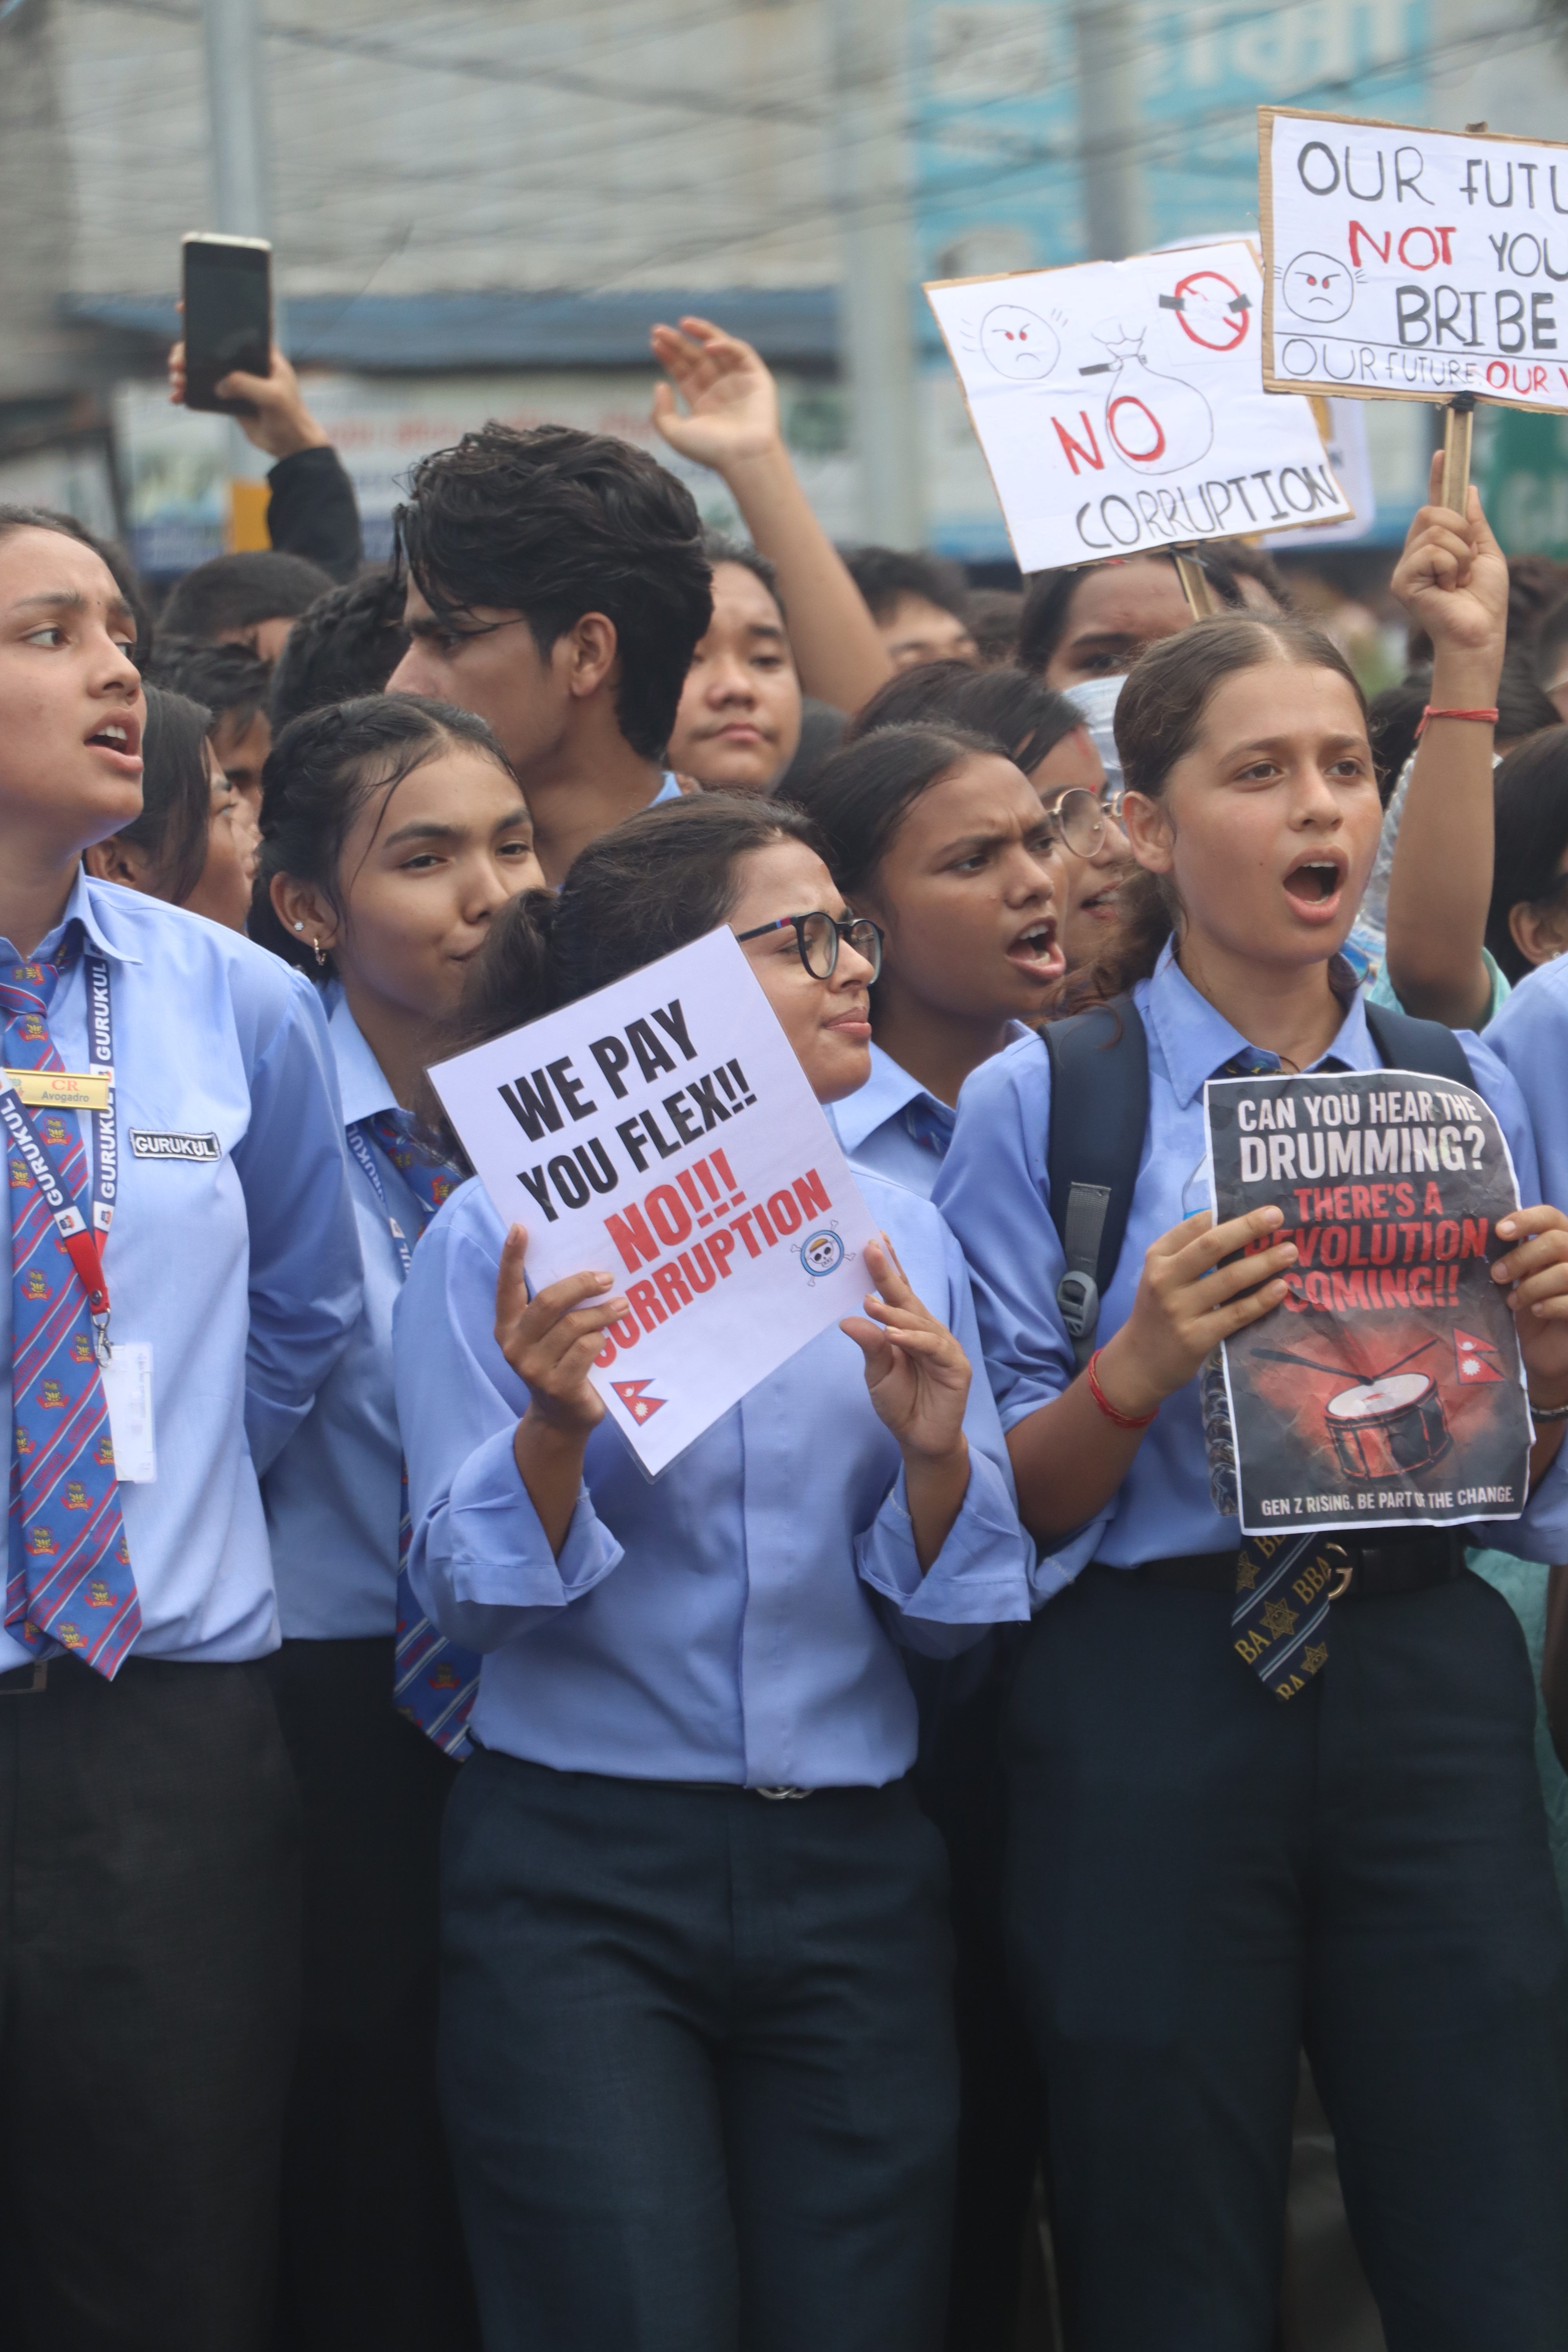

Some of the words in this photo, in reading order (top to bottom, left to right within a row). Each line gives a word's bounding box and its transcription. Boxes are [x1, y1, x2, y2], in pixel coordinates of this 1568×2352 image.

[1298, 142, 1435, 205] OUR
[1349, 220, 1456, 271] NOT
[1396, 285, 1557, 354] BRIBE
[1282, 338, 1377, 380] OUR
[1486, 361, 1549, 395] OUR
[1051, 396, 1165, 475] NO
[1076, 465, 1341, 548] CORRUPTION
[93, 963, 111, 1061] GURUKUL
[42, 1091, 89, 1103] Avogadro
[52, 1080, 80, 1091] CR
[497, 1055, 598, 1142] WE
[588, 998, 698, 1100] PAY
[1238, 1098, 1296, 1132] CAN
[1304, 1095, 1360, 1127] YOU
[1369, 1091, 1435, 1123] HEAR
[1435, 1092, 1483, 1122] THE
[1, 1098, 64, 1206] GURUKUL
[136, 1137, 216, 1156] GURUKUL
[516, 1137, 619, 1223] YOU
[615, 1058, 758, 1173] FLEX!!
[1240, 1125, 1486, 1183] DRUMMING?
[603, 1147, 747, 1274] NO!!!
[1294, 1182, 1416, 1222] THERE'S
[1423, 1181, 1445, 1215] A
[1282, 1265, 1459, 1313] COMING!!
[1261, 1499, 1290, 1516] GEN
[1294, 1497, 1303, 1514] Z
[1306, 1494, 1354, 1513] RISING.
[1357, 1493, 1375, 1509] BE
[1378, 1491, 1412, 1508] PART
[1413, 1493, 1425, 1508] OF
[1427, 1492, 1454, 1508] THE
[1457, 1486, 1514, 1506] CHANGE.
[1292, 1556, 1331, 1605] BBA
[1234, 1629, 1271, 1664] BA
